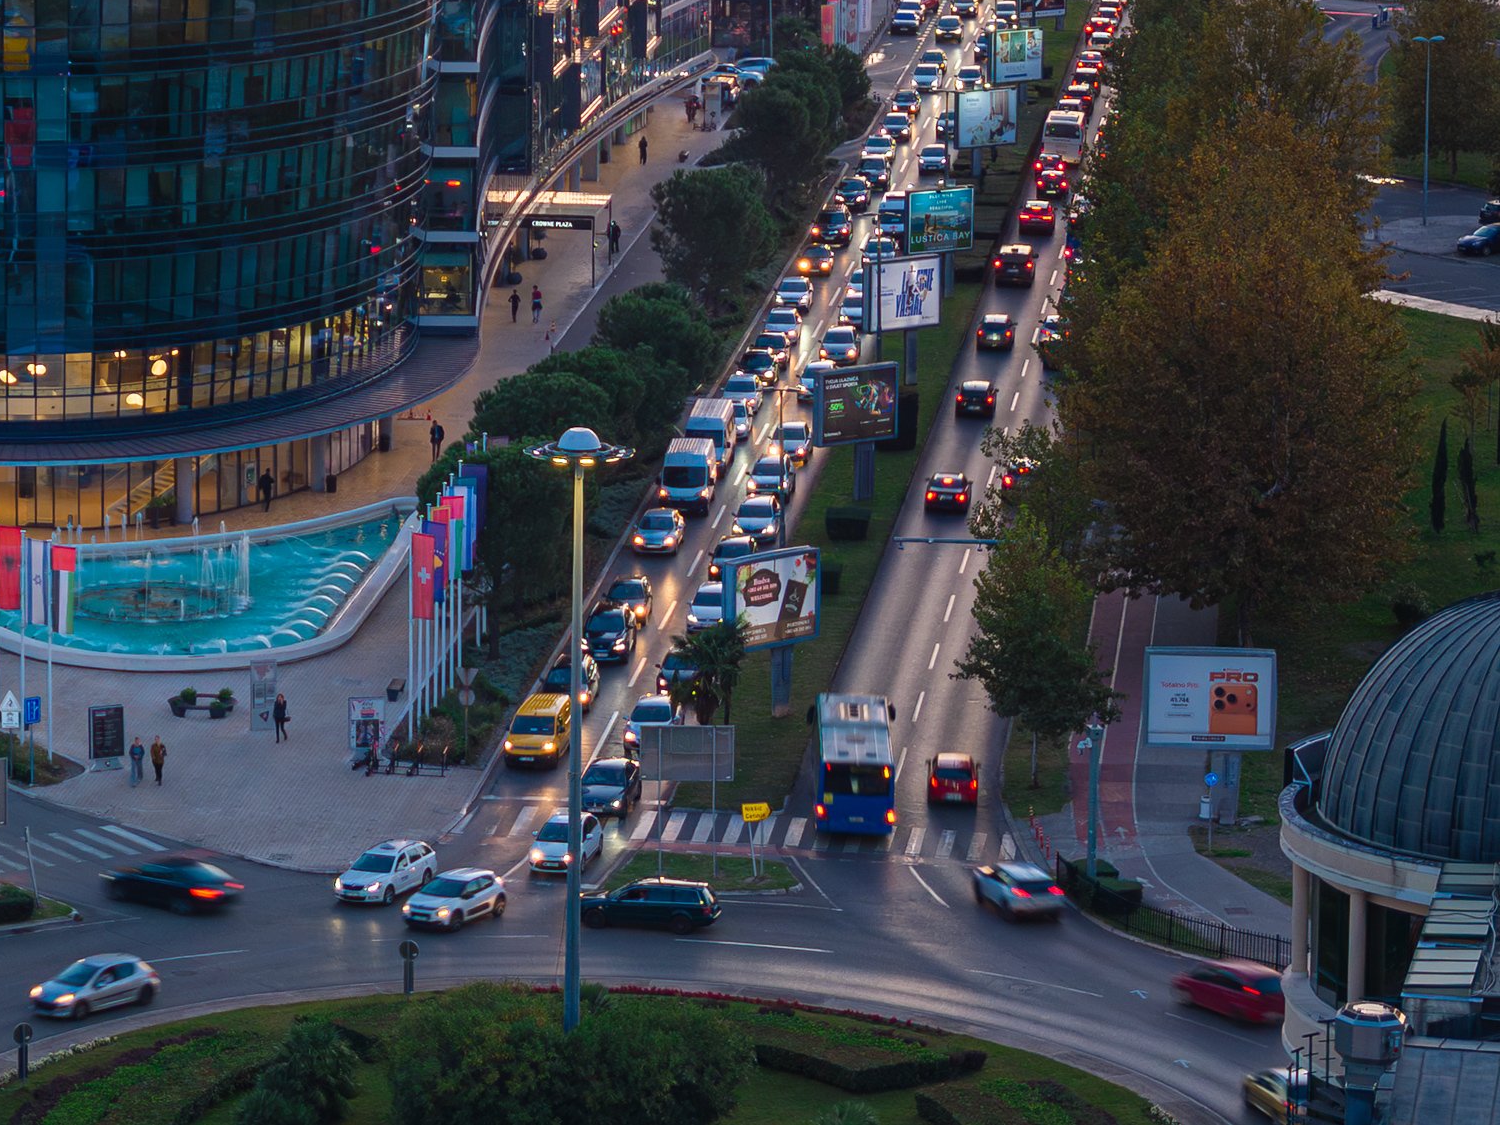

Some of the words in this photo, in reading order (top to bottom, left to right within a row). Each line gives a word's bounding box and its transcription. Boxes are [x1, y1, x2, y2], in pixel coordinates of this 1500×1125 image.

[952, 231, 971, 240] BAY
[828, 402, 844, 411] -50%
[1209, 672, 1259, 682] PRO
